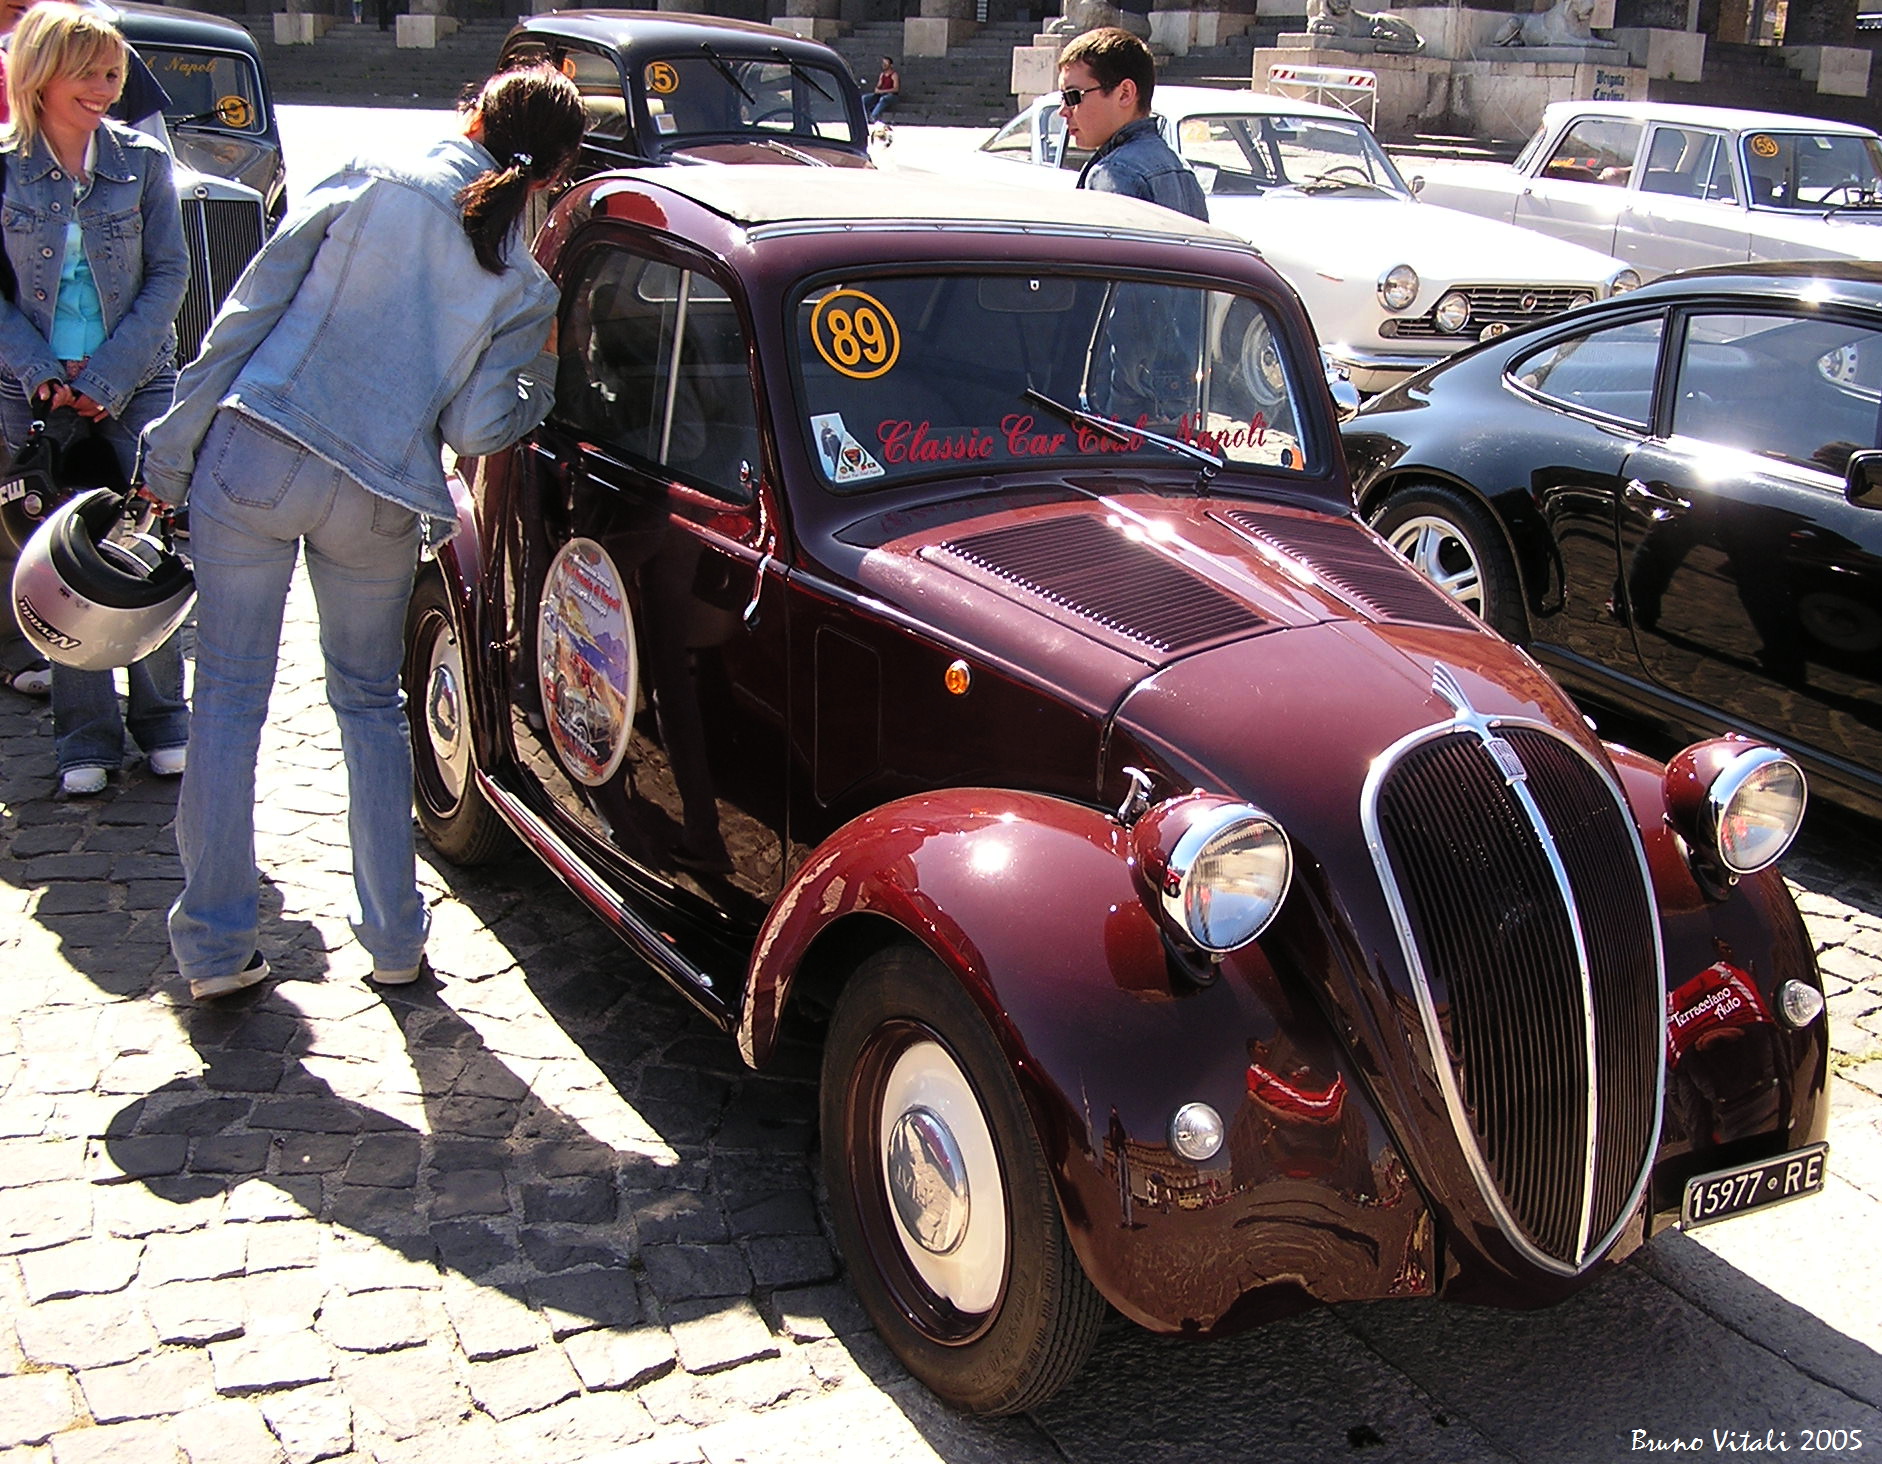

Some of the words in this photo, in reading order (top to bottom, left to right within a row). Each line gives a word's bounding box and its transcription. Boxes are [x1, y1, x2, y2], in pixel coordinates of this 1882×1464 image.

[164, 56, 217, 77] Napoli
[654, 65, 672, 91] 5
[827, 307, 887, 366] 89
[876, 419, 994, 464] Classic
[1000, 413, 1066, 456] Car
[1173, 410, 1267, 457] Napoli
[19, 597, 82, 650] Nevada
[1672, 987, 1732, 1028] Terracciano
[1714, 997, 1741, 1020] Auto
[1693, 1170, 1764, 1218] 15977
[1784, 1155, 1822, 1195] RE
